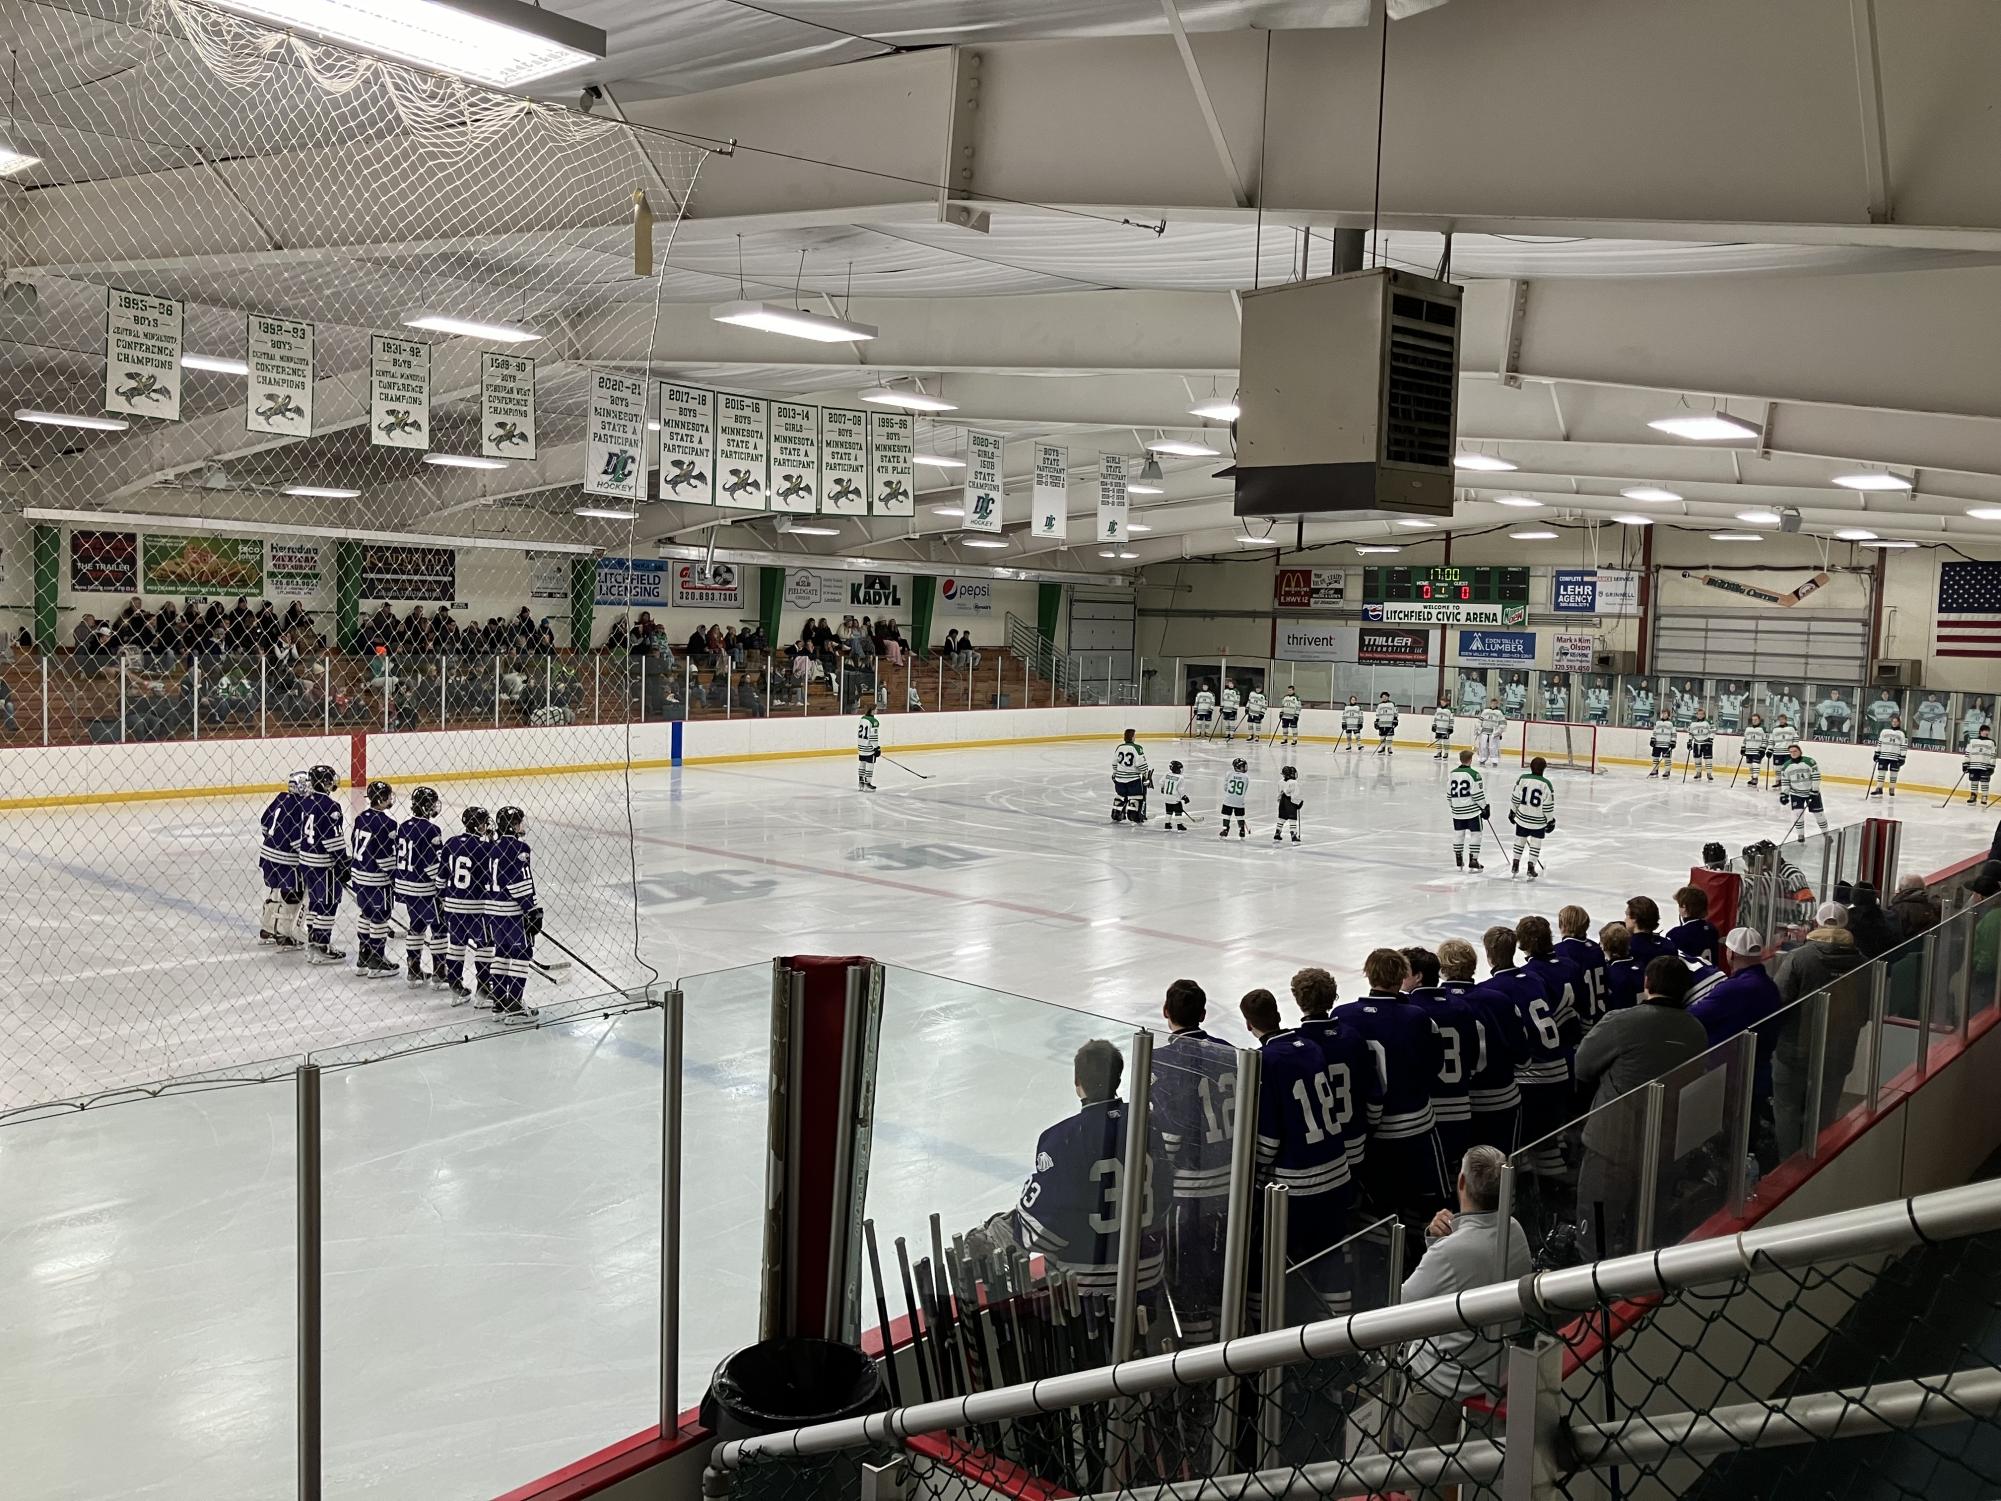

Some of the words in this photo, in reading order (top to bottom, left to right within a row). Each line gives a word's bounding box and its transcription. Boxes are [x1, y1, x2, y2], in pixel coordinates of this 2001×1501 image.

[133, 315, 159, 328] BOYS
[116, 338, 175, 358] CONFERENCE
[270, 338, 293, 352] BOYS
[116, 351, 174, 371] CHAMPIONS
[392, 357, 412, 369] BOYS
[255, 361, 307, 379] CONFERENCE
[256, 374, 306, 391] CHAMPIONS
[378, 379, 424, 395] CONFERENCE
[379, 391, 423, 407] CHAMPIONS
[488, 394, 529, 408] CONFERENCE
[609, 395, 630, 408] BOYS
[668, 388, 707, 406] 2017-18
[488, 405, 528, 418] CHAMPIONS
[678, 406, 697, 418] BOYS
[734, 413, 752, 425] BOYS
[600, 420, 629, 435] STATE
[631, 425, 638, 436] A
[663, 418, 710, 434] MINNESOTA
[720, 425, 764, 440] MINNESOTA
[784, 422, 803, 433] GIRLS
[837, 427, 853, 438] BOYS
[669, 431, 695, 444] STATE
[697, 436, 704, 445] A
[773, 434, 815, 447] MINNESOTA
[885, 431, 901, 441] BOYS
[663, 443, 710, 458] PARTICIPANT
[726, 438, 750, 450] STATE
[752, 441, 758, 451] A
[825, 439, 863, 452] MINNESOTA
[874, 443, 912, 454] MINNESOTA
[720, 448, 764, 463] PARTICIPANT
[779, 446, 801, 457] STATE
[803, 449, 810, 458] A
[831, 450, 852, 461] STATE
[853, 454, 859, 462] A
[977, 449, 995, 460] GIRLS
[1043, 447, 1060, 457] BOYS
[773, 457, 815, 470] PARTICIPANT
[880, 454, 901, 464] STATE
[902, 456, 908, 465] A
[1042, 456, 1060, 467] STATE
[825, 461, 864, 474] PARTICIPANT
[876, 465, 889, 475] 4TH
[891, 466, 911, 476] PLACE
[1036, 464, 1066, 475] PARTICIPANT
[974, 470, 995, 482] STATE
[596, 480, 634, 492] HOCKEY
[968, 480, 1000, 493] CHAMPIONS
[970, 519, 993, 527] HOCKEY
[76, 562, 93, 571] THE
[95, 563, 130, 572] TRAILER
[597, 571, 661, 586] LITCHFIELD
[1430, 568, 1460, 581] 17:00
[599, 584, 660, 598] LICENSING
[959, 583, 990, 600] pepsi
[1423, 586, 1431, 599] 0
[1461, 586, 1470, 599] 0
[1560, 585, 1593, 595] LEHR
[1557, 594, 1593, 603] AGENCY
[1385, 609, 1433, 624] LITCHFIELD
[1435, 610, 1462, 623] CIVIC
[1464, 611, 1499, 624] ARENA
[1286, 633, 1334, 647] thrivent
[1363, 636, 1412, 646] MILLER
[1578, 636, 1591, 644] Kim
[1485, 643, 1524, 654] LUMBER
[1570, 643, 1591, 651] Olson
[1228, 779, 1245, 796] 39
[1450, 779, 1471, 798] 22
[1520, 786, 1543, 807] 16
[397, 837, 414, 872] 21
